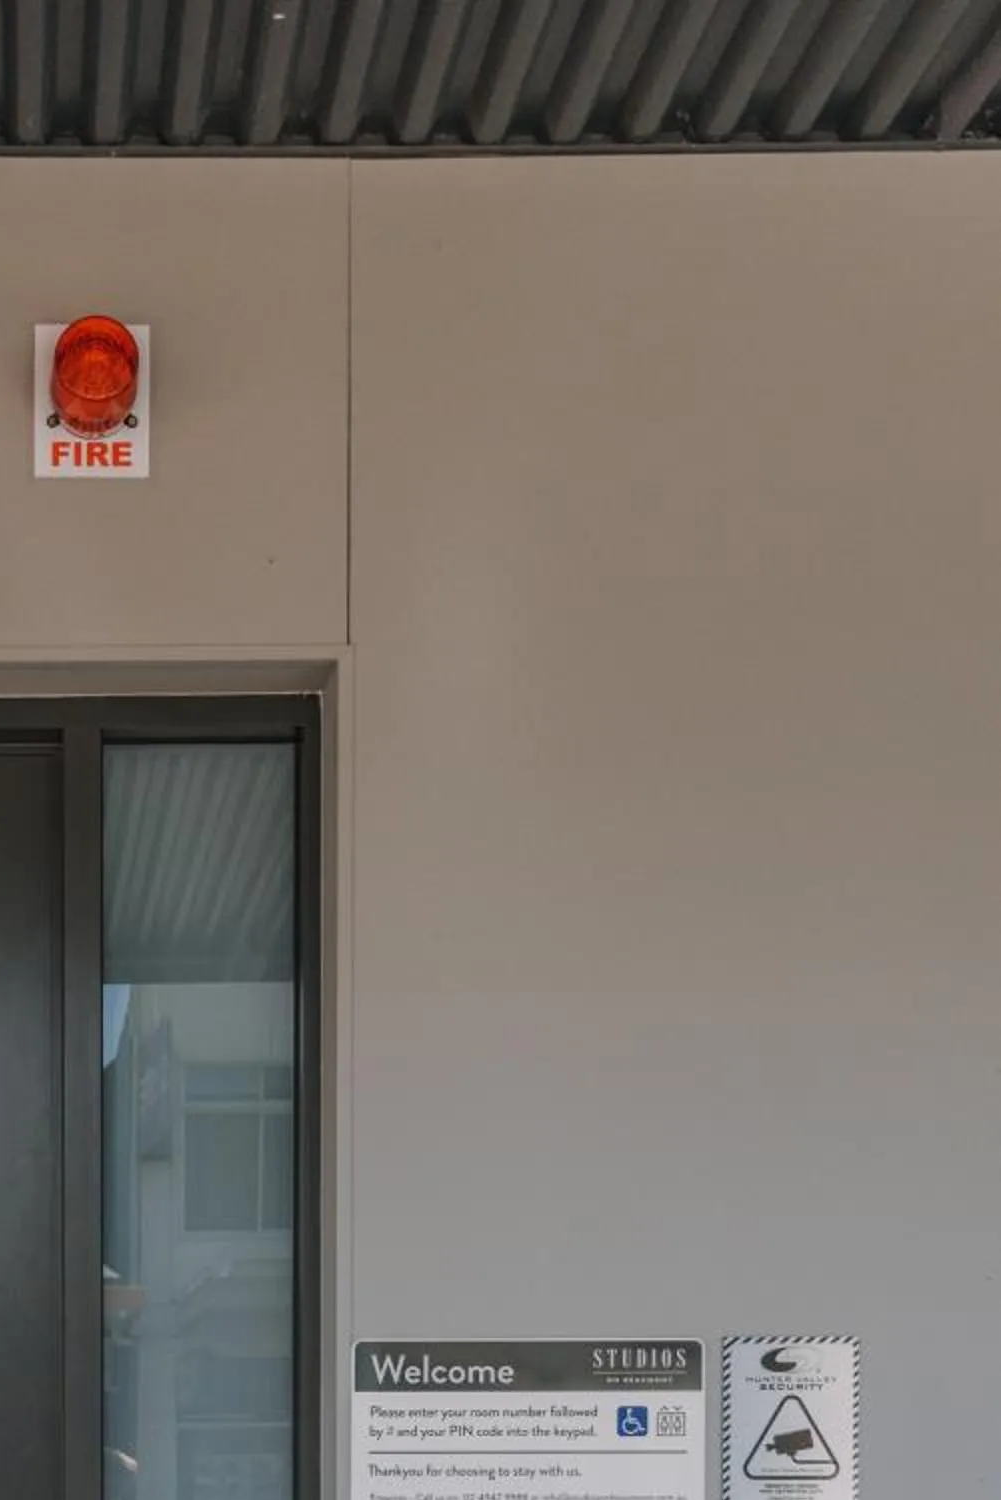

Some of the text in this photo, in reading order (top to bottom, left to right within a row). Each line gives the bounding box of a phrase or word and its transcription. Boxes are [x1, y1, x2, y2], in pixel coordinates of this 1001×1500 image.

[52, 441, 133, 468] FIRE
[592, 1347, 687, 1369] STUDIOS
[371, 1353, 515, 1384] Welcome
[370, 1405, 598, 1421] Please enter your room number followed
[369, 1425, 383, 1440] by
[397, 1425, 418, 1437] and
[419, 1428, 446, 1440] your
[449, 1425, 474, 1437] PIN
[476, 1425, 503, 1437] code
[506, 1426, 528, 1437] into
[531, 1424, 551, 1437] the
[369, 1463, 423, 1480] Thankyou
[426, 1463, 442, 1477] for
[445, 1463, 496, 1481] choosing
[498, 1466, 510, 1477] to
[512, 1466, 536, 1480] stay
[539, 1464, 564, 1477] with
